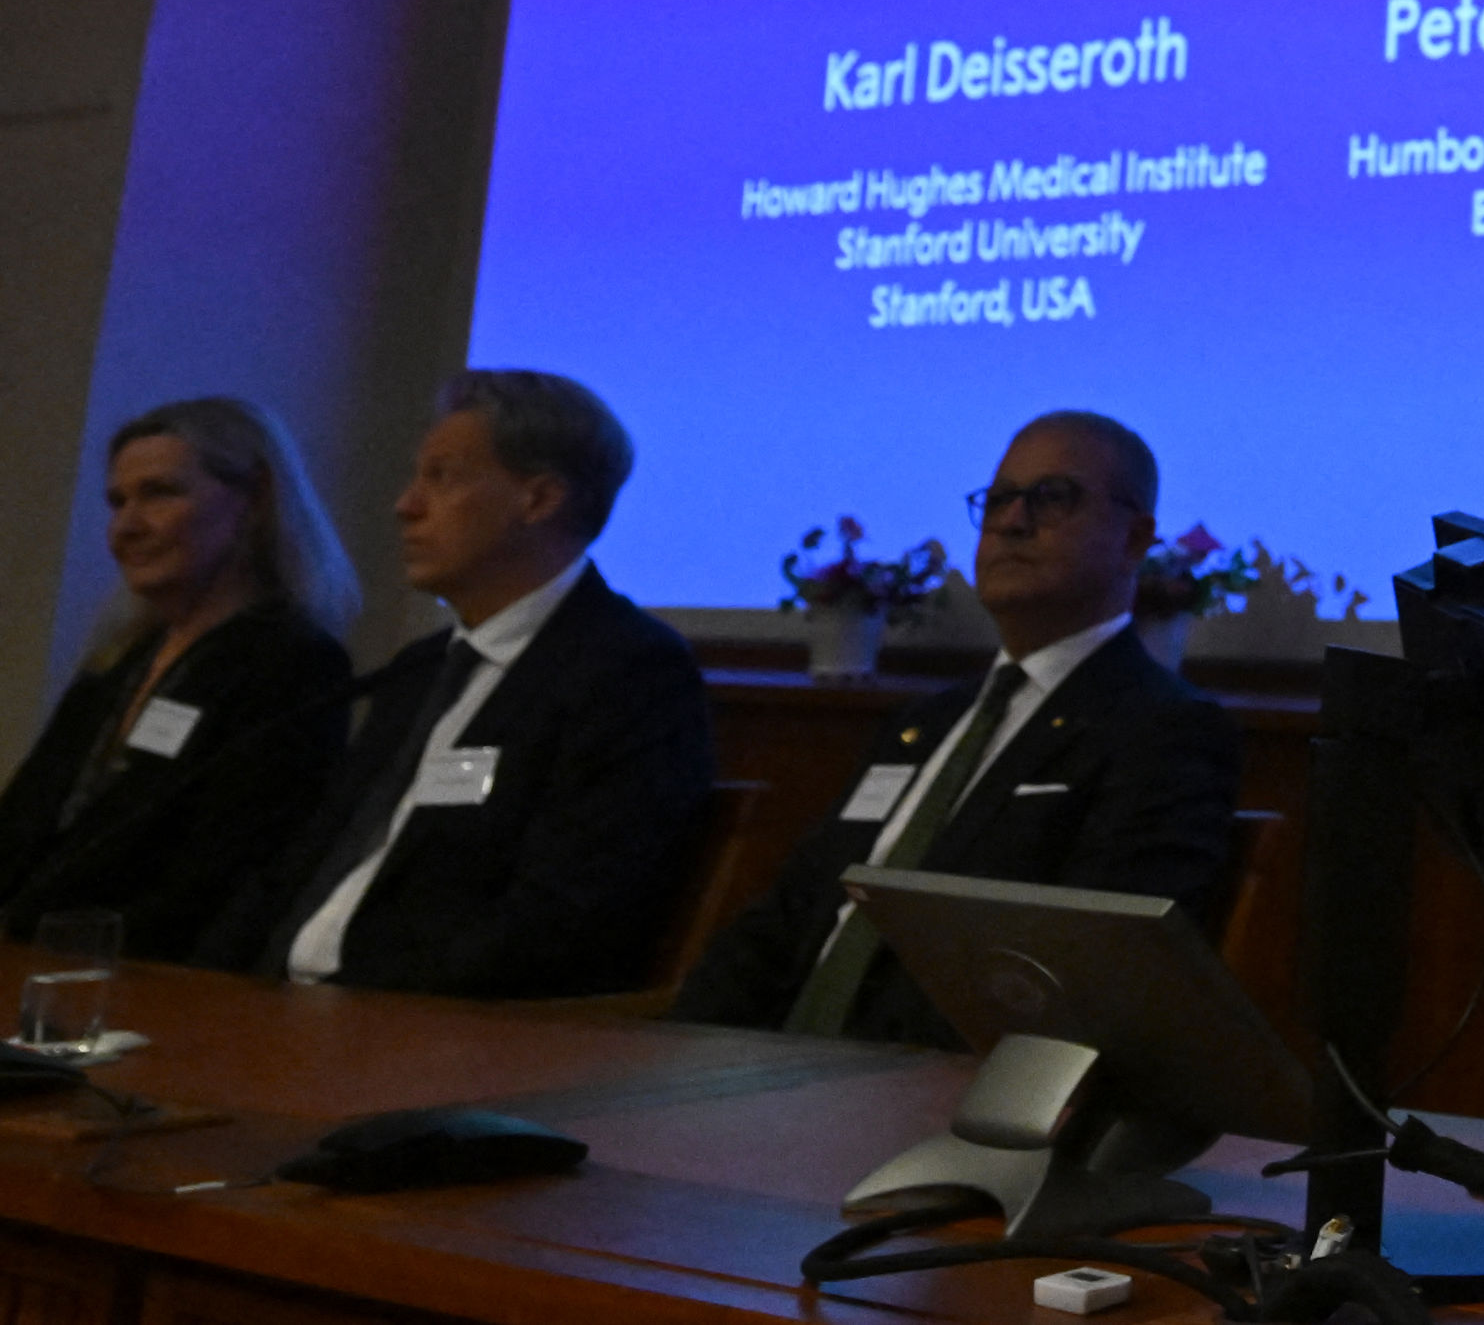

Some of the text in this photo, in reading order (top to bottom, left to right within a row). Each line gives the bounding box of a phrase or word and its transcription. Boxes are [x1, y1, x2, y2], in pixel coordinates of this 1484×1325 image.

[823, 16, 1188, 112] Karl Deisseroth
[741, 142, 1267, 220] Howard Hughes Medical Institute
[834, 211, 1145, 271] Stanford University
[868, 276, 1096, 329] Stanford, USA
